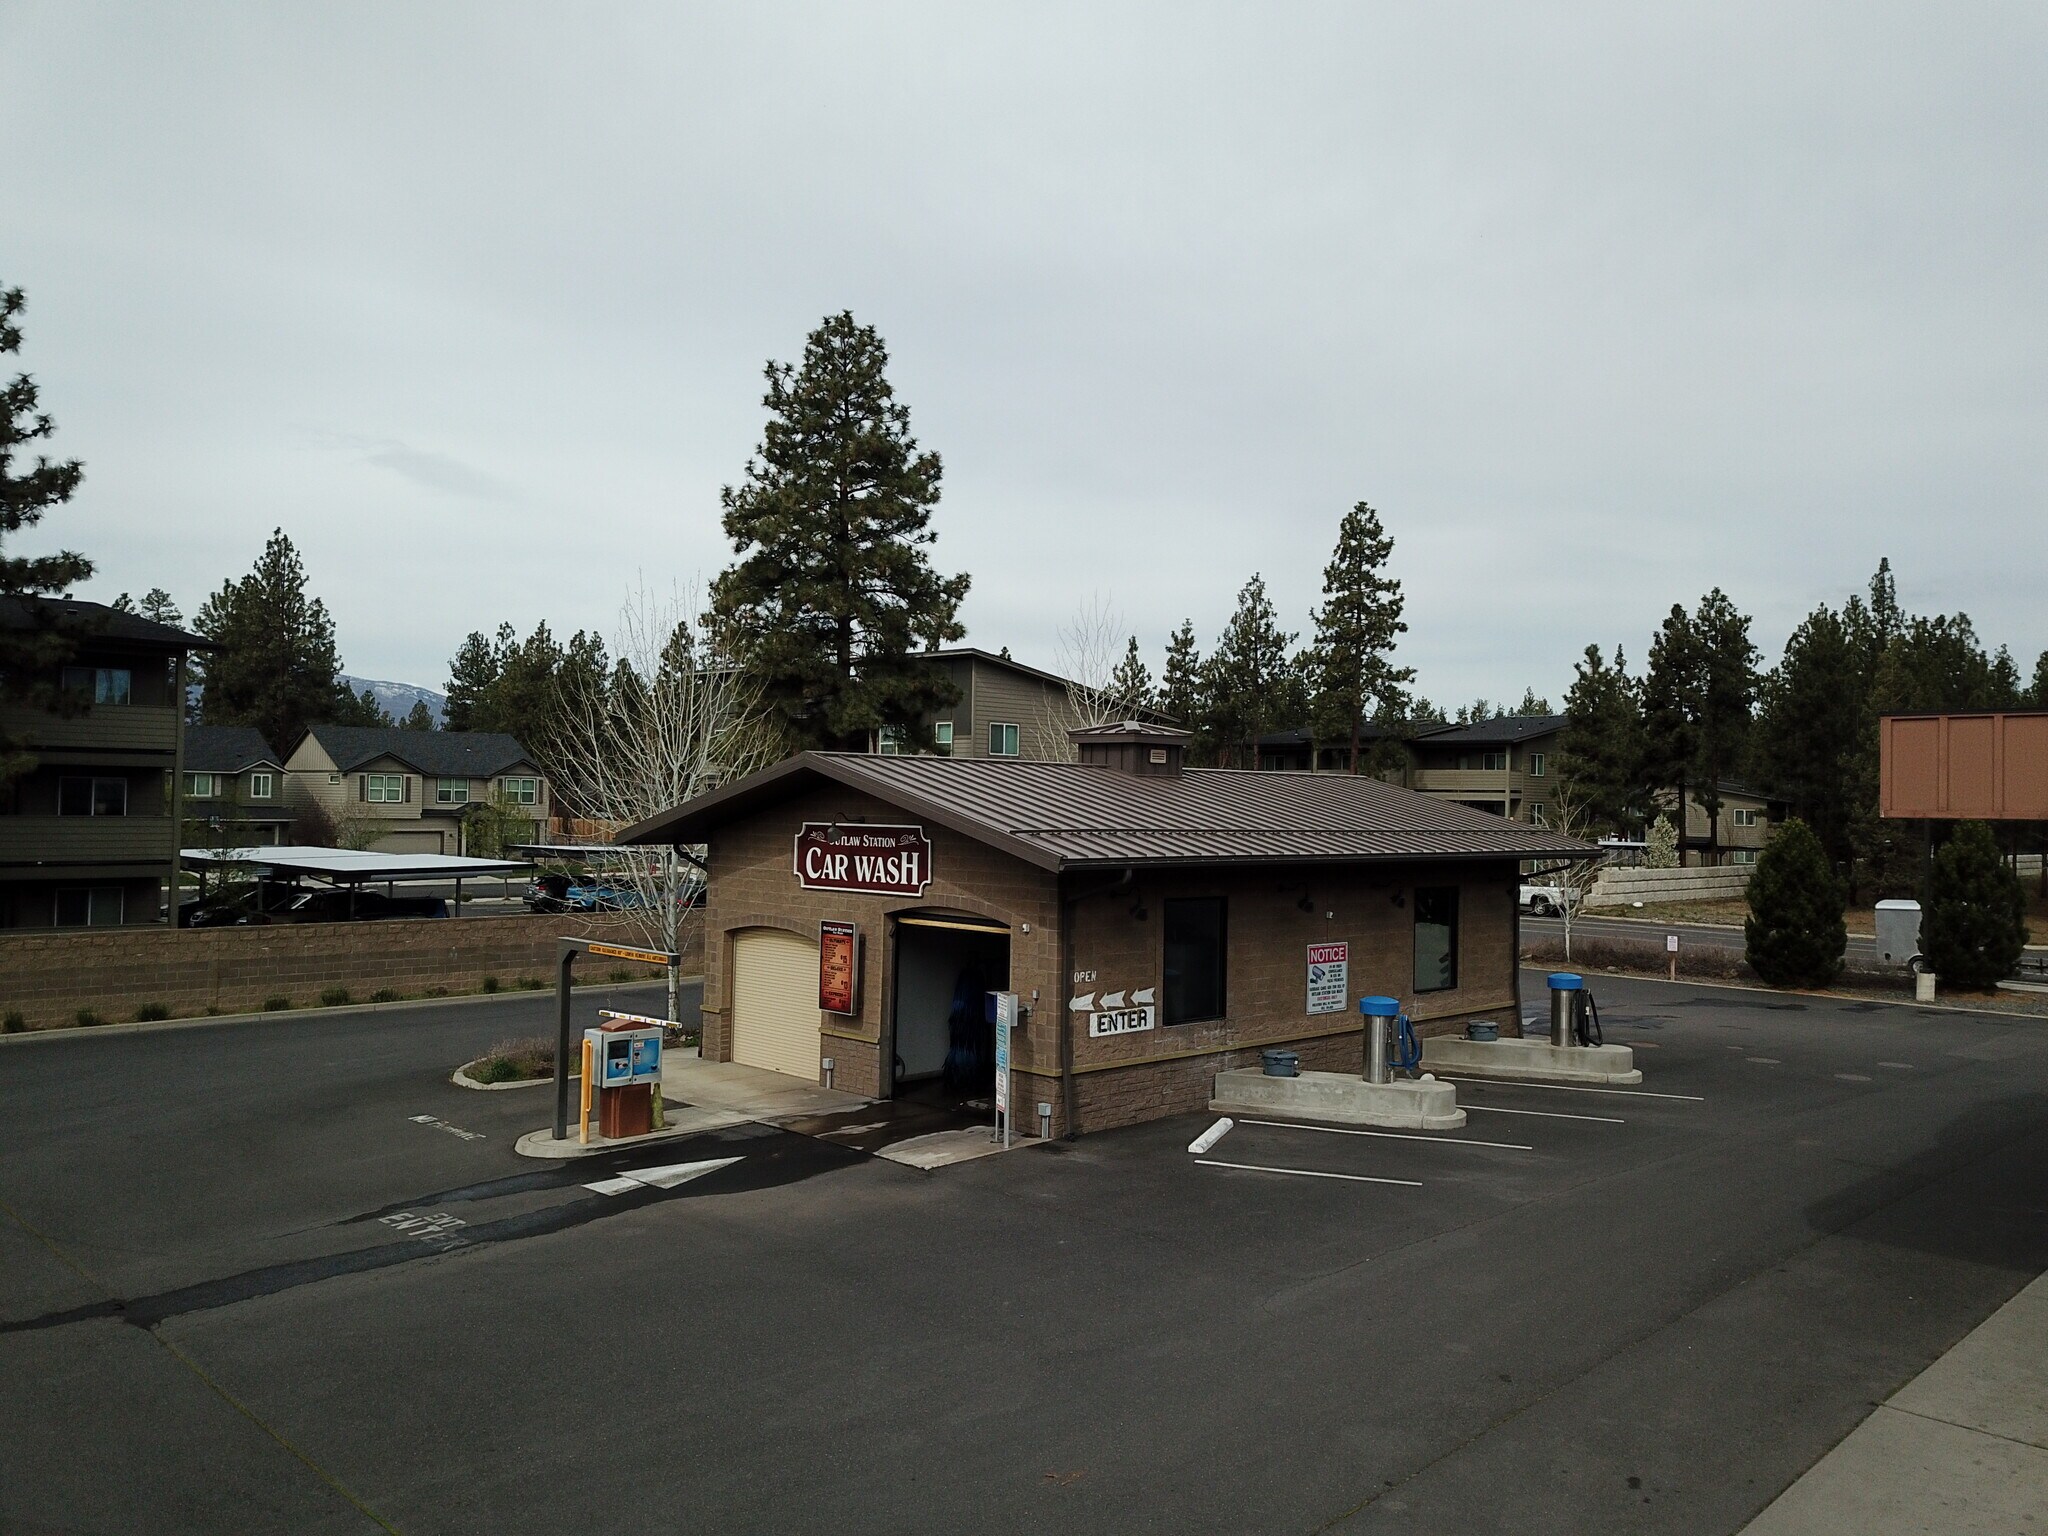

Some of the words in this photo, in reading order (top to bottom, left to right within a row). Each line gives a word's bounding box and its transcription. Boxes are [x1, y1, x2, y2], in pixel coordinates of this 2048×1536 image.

[829, 835, 861, 847] UTLAW
[863, 834, 896, 848] STATION
[805, 847, 849, 882] CAR
[853, 851, 920, 886] WASH
[1310, 947, 1345, 963] NOTICE
[1074, 970, 1097, 983] OPEN
[1096, 1008, 1147, 1034] ENTER
